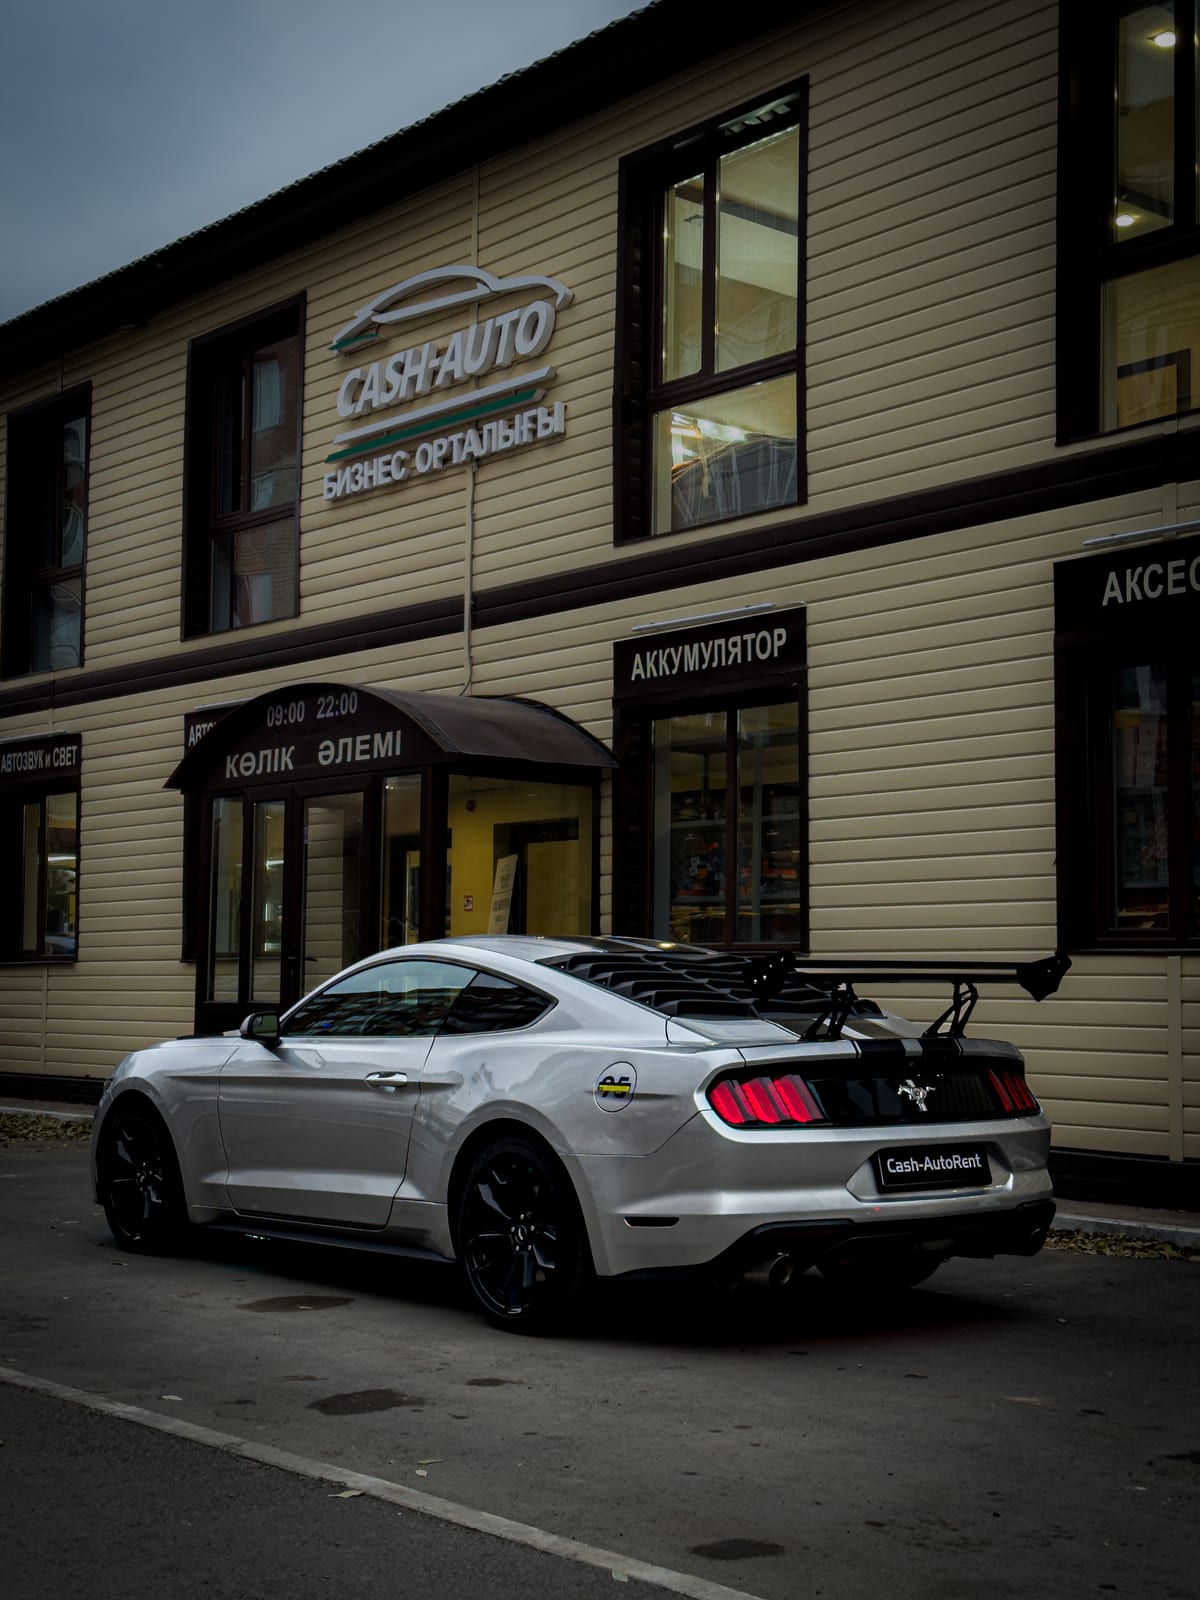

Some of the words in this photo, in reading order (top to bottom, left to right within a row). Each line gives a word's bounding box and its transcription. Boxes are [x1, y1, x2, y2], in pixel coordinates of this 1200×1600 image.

[337, 300, 556, 419] CASH-AUTO
[323, 450, 411, 500] БИЗНЕС
[415, 401, 566, 473] ОРТАЛЫҒЫ
[631, 627, 787, 681] АККУМУЛЯТОР
[266, 701, 305, 728] 09:00
[316, 691, 359, 720] 22:00
[0, 749, 45, 773] АВТОЗВУК
[52, 745, 78, 768] СВЕТ
[225, 745, 295, 779] КӨЛІК
[317, 729, 401, 767] ӘЛЕМІ
[886, 1152, 982, 1174] Cash-AutoRent
